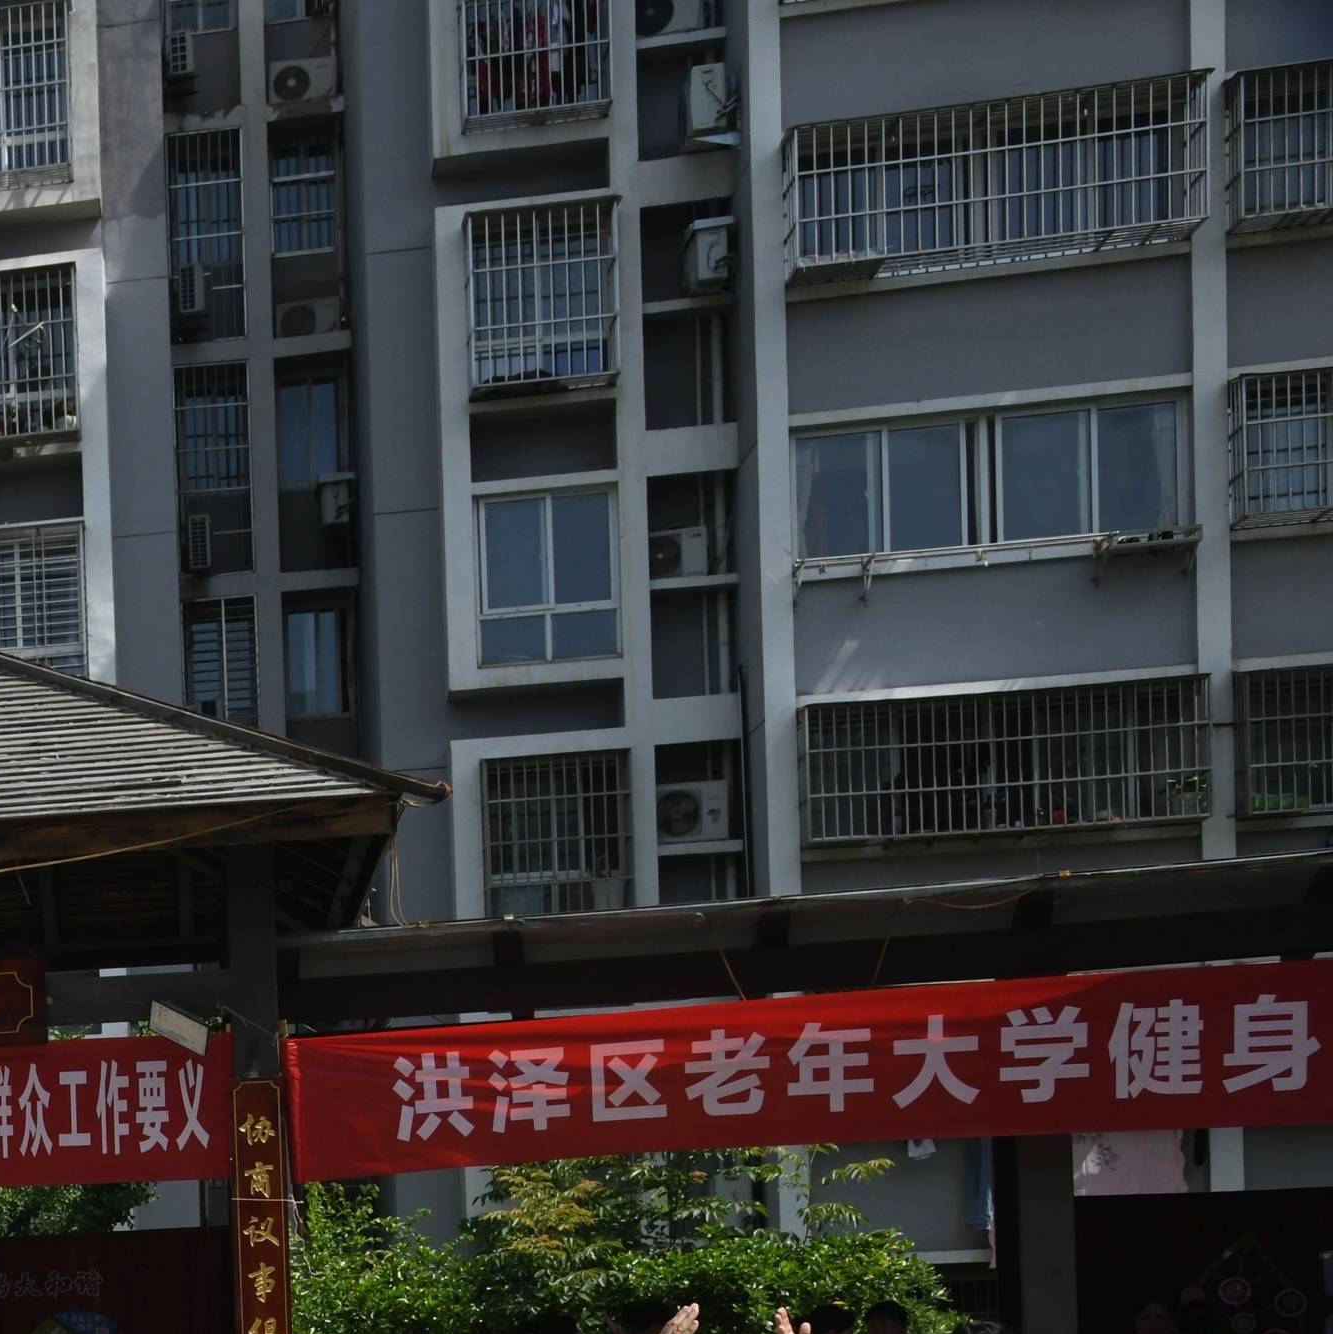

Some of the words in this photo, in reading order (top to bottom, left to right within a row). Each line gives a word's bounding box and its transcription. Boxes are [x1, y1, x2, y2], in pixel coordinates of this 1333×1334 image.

[391, 992, 1321, 1144] 洪泽区老年大学健身
